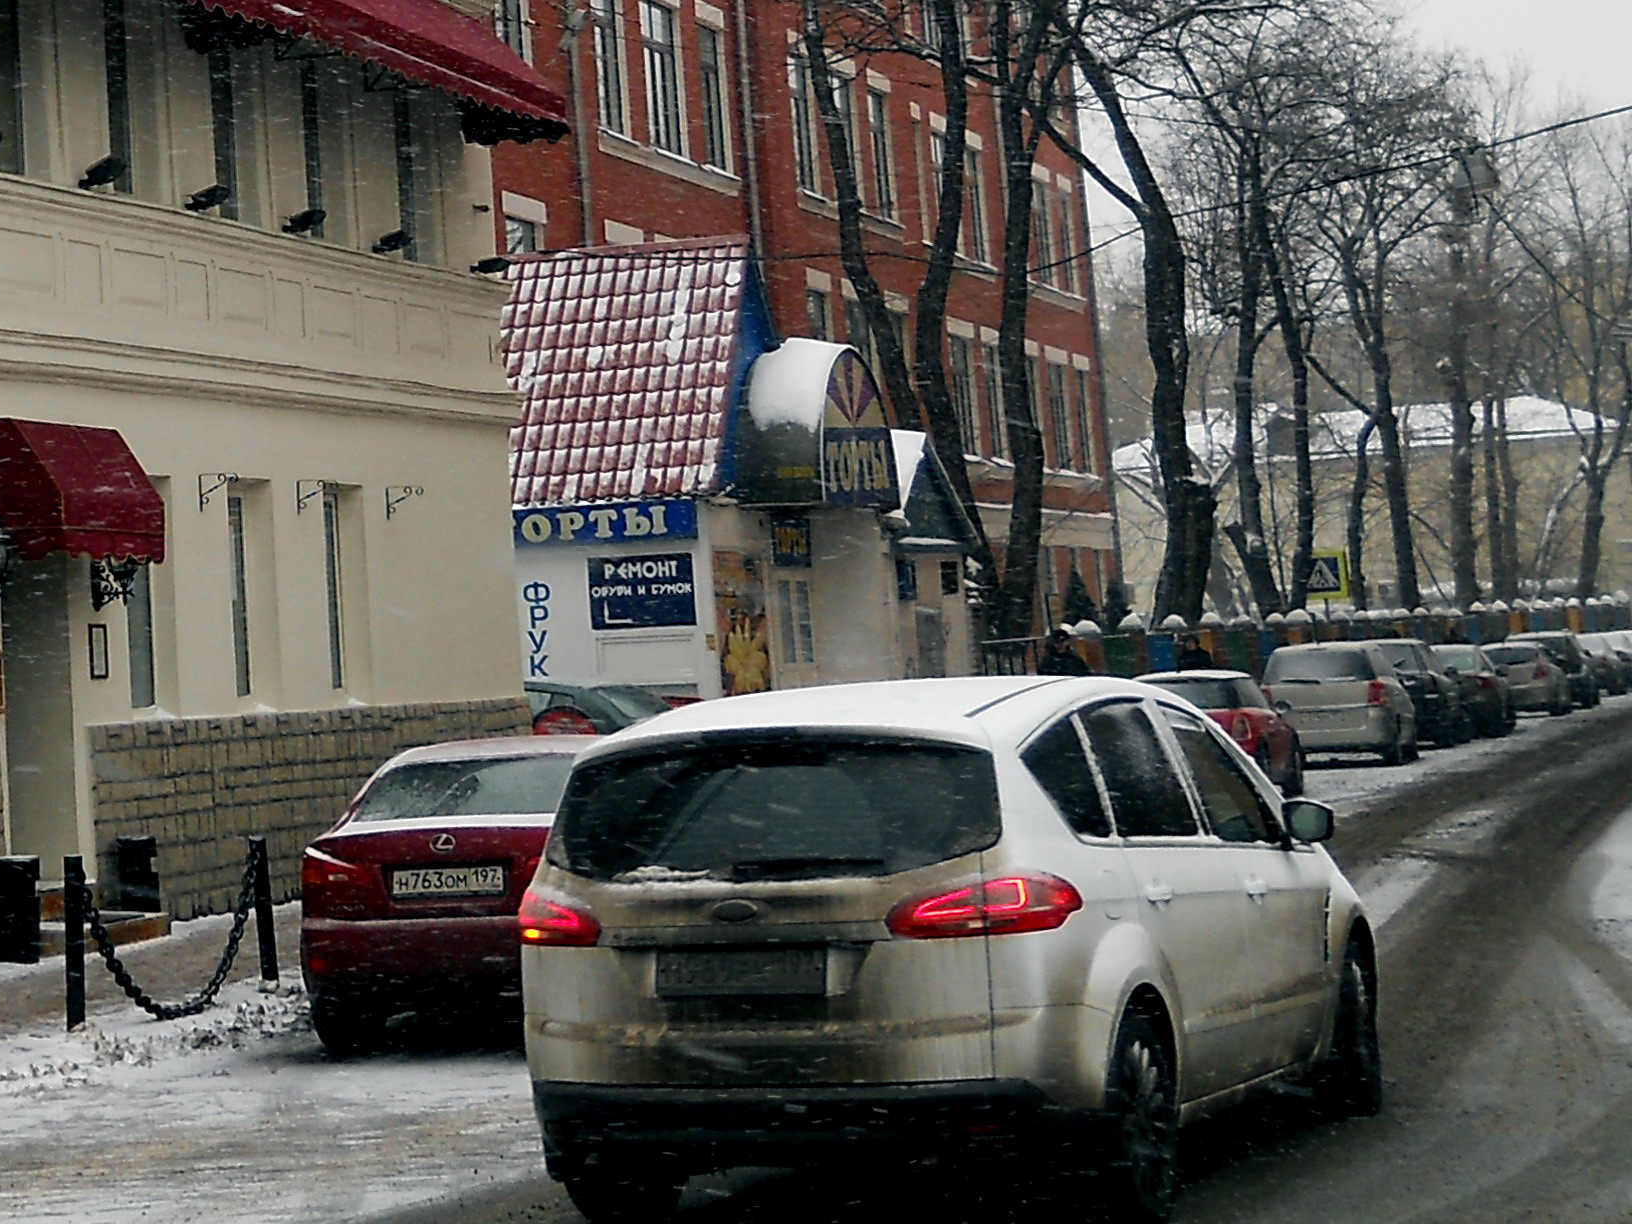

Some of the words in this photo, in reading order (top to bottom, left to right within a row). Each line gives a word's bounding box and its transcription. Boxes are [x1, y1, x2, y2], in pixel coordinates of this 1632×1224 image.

[825, 437, 891, 494] ТОРТЫ
[516, 504, 669, 544] ОРТЫ
[603, 559, 678, 580] РЕМОНТ
[591, 585, 633, 598] ОБУВИ
[637, 584, 647, 596] И
[651, 582, 693, 596] СУМОК
[471, 868, 499, 883] 197
